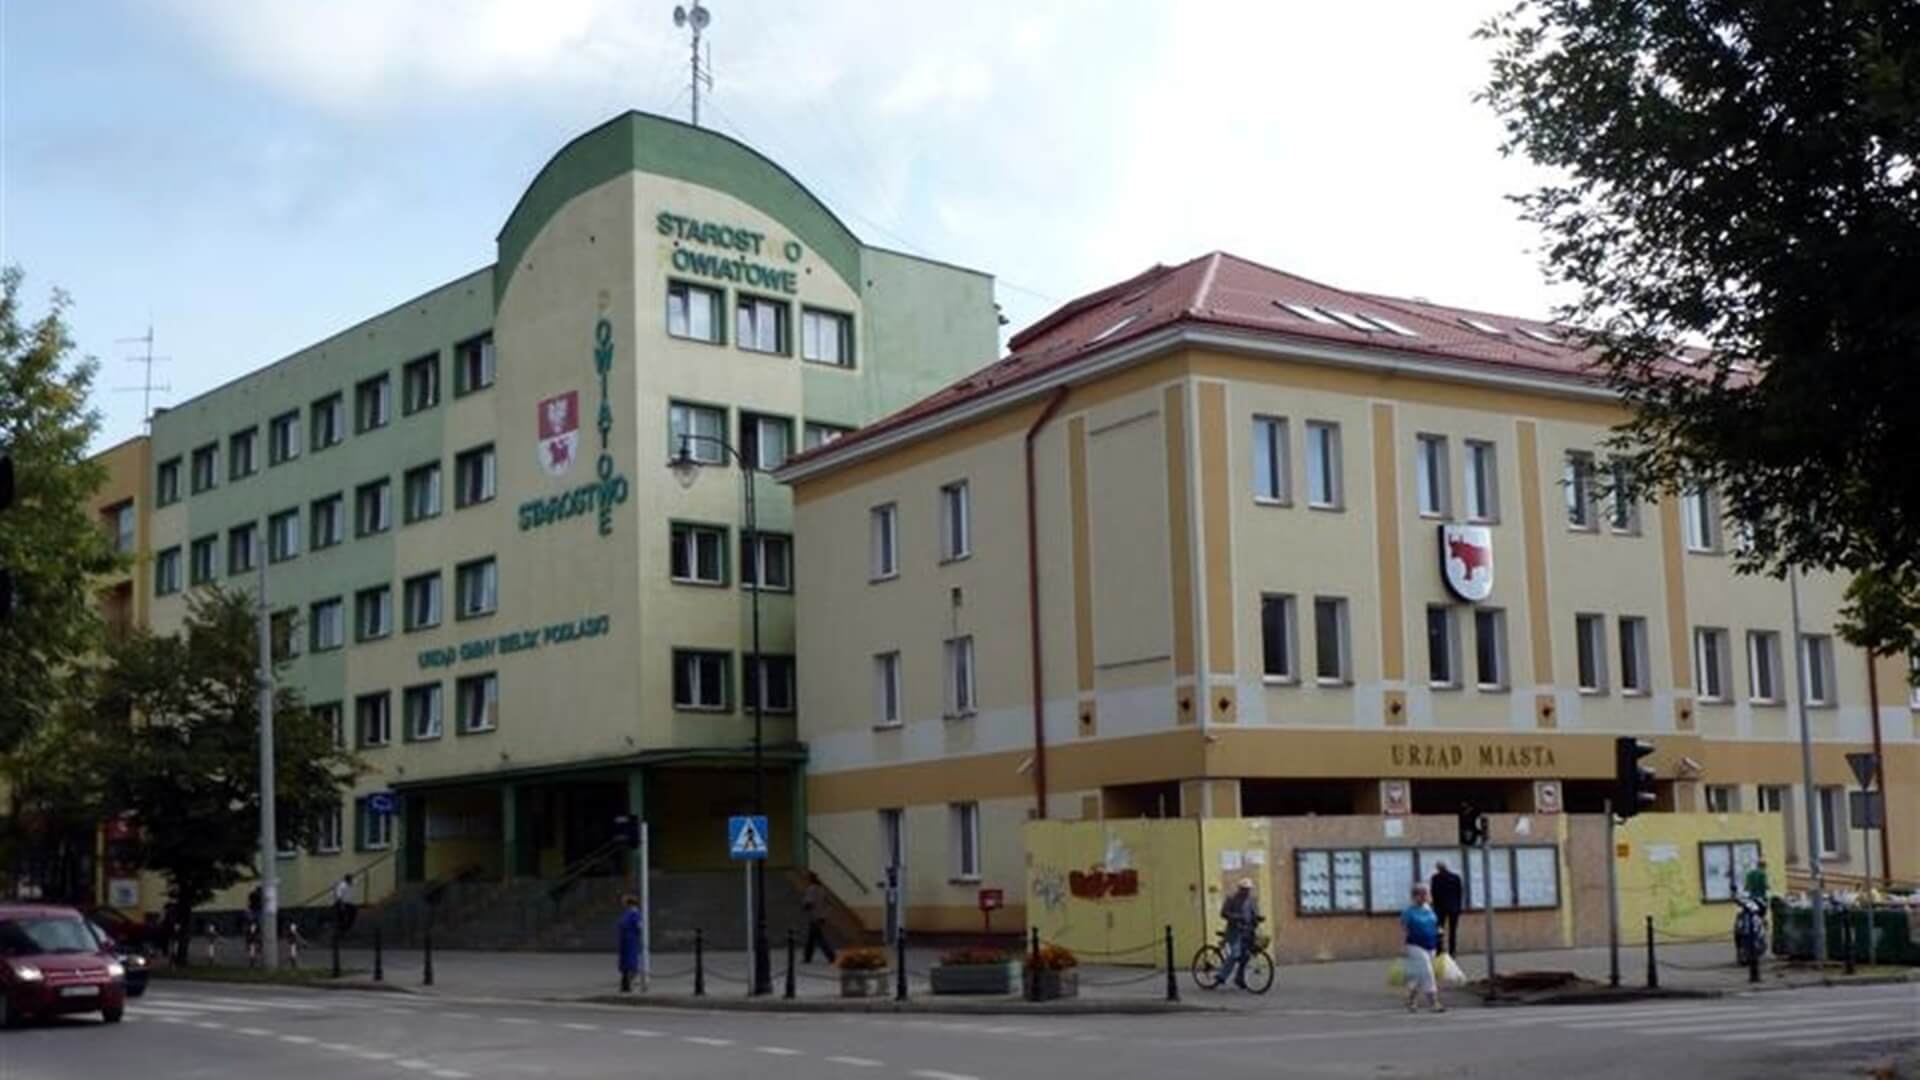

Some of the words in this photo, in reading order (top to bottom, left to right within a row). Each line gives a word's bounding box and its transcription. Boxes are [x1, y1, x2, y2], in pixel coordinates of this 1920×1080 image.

[656, 211, 802, 262] STAROSTO
[660, 242, 798, 294] OWIATOWE
[594, 290, 614, 536] OWIATOWE
[1391, 745, 1463, 769] URZĄD
[1479, 744, 1556, 767] MIASTA
